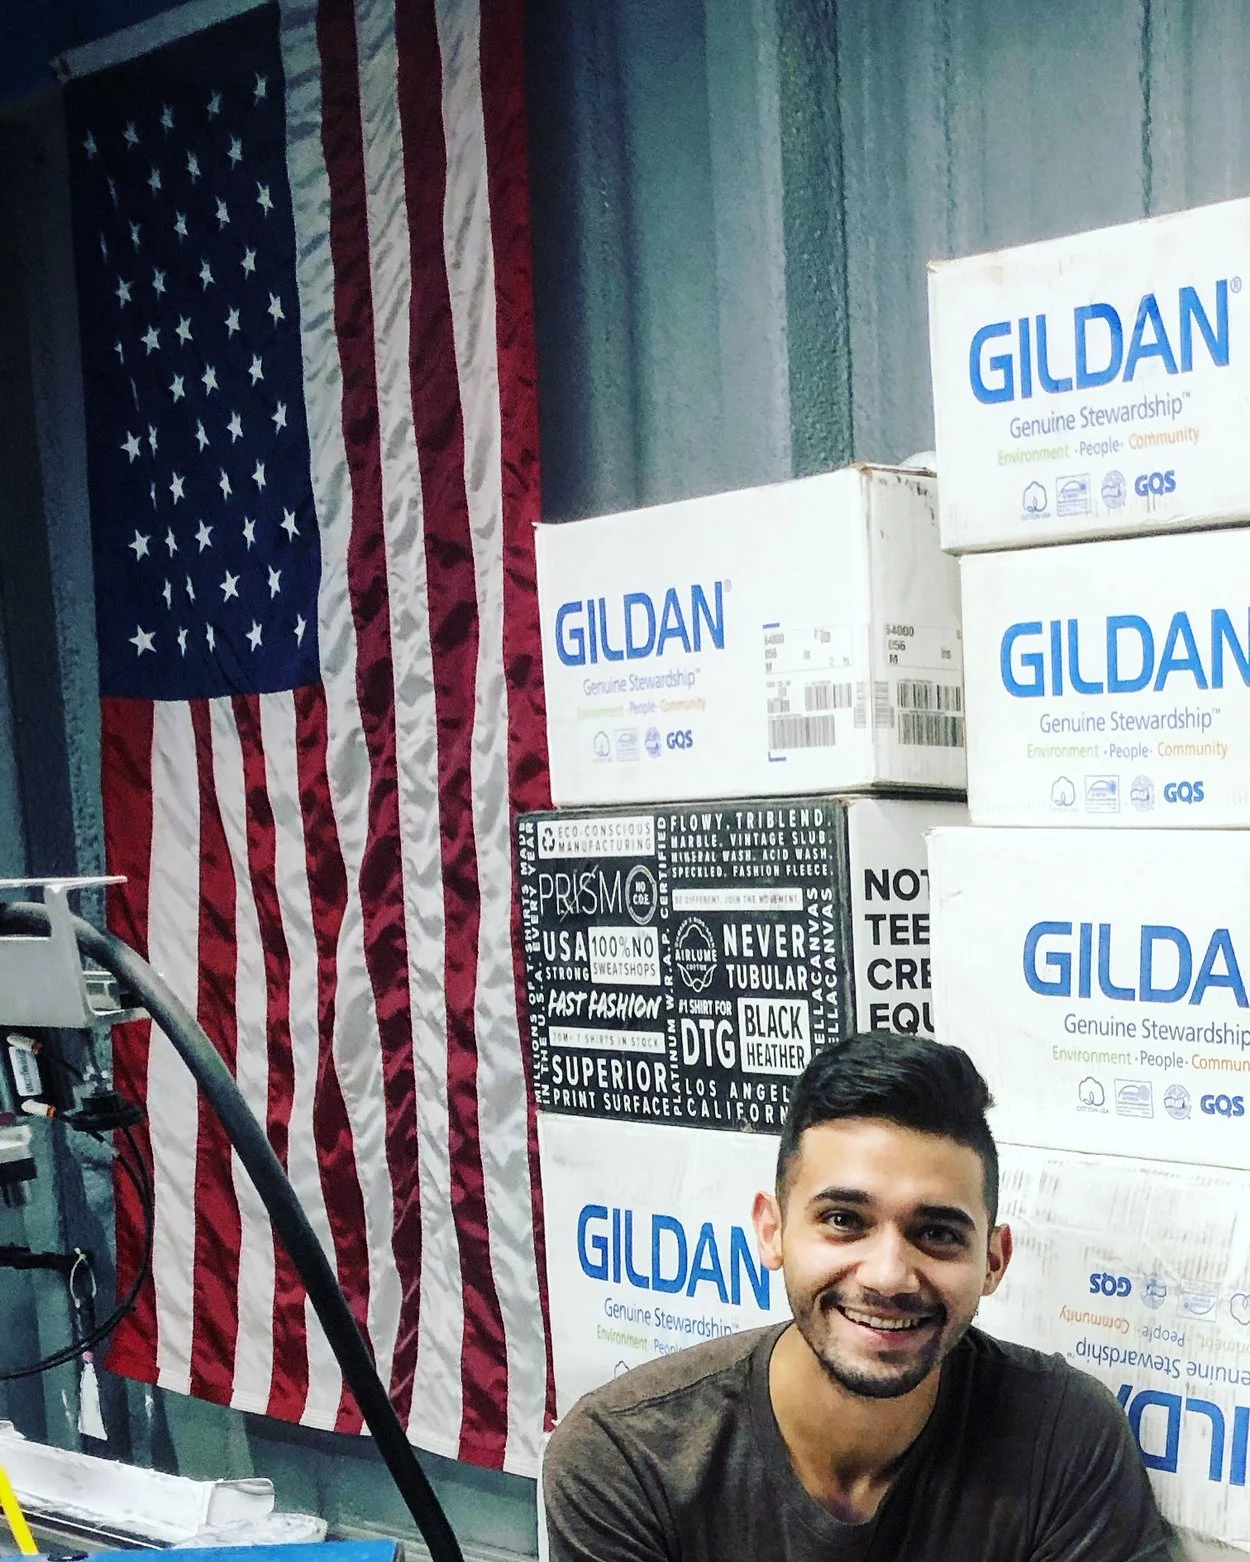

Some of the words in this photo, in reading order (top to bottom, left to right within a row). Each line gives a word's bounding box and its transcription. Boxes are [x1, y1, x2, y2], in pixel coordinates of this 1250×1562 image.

[969, 278, 1230, 405] GILDAN
[1009, 399, 1075, 440] Genuine
[997, 442, 1069, 466] Environment
[1128, 425, 1200, 450] Community
[1135, 470, 1176, 499] GQS
[555, 581, 726, 667] GILDAN
[583, 677, 626, 696] Genuine
[1039, 709, 1106, 734] Genuine
[666, 730, 694, 752] GQS
[1157, 740, 1228, 760] Community
[1164, 781, 1204, 805] GQS
[730, 832, 784, 846] VINTAGE
[539, 870, 623, 916] PRISM
[543, 931, 588, 962] USA
[723, 924, 806, 958] NEVER
[546, 967, 589, 981] STRONG
[593, 962, 656, 977] SWEATSHOPS
[726, 964, 808, 991] TUBULAR
[548, 989, 588, 1017] FAST
[588, 990, 662, 1021] FASHION
[690, 999, 713, 1015] SHIRT
[715, 1000, 732, 1016] FOR
[744, 1004, 803, 1040] BLACK
[1064, 1014, 1137, 1039] Genuine
[680, 1018, 736, 1069] DTG
[747, 1042, 805, 1070] HEATHER
[552, 1055, 668, 1093] SUPERIOR
[667, 1019, 682, 1116] PLATINUM
[685, 1078, 717, 1097] LOS
[553, 1089, 595, 1109] PRINT
[604, 1093, 670, 1116] SURFACE
[1200, 1095, 1244, 1119] GQS
[1089, 1272, 1132, 1298] GQS
[604, 1298, 651, 1326] Genuine
